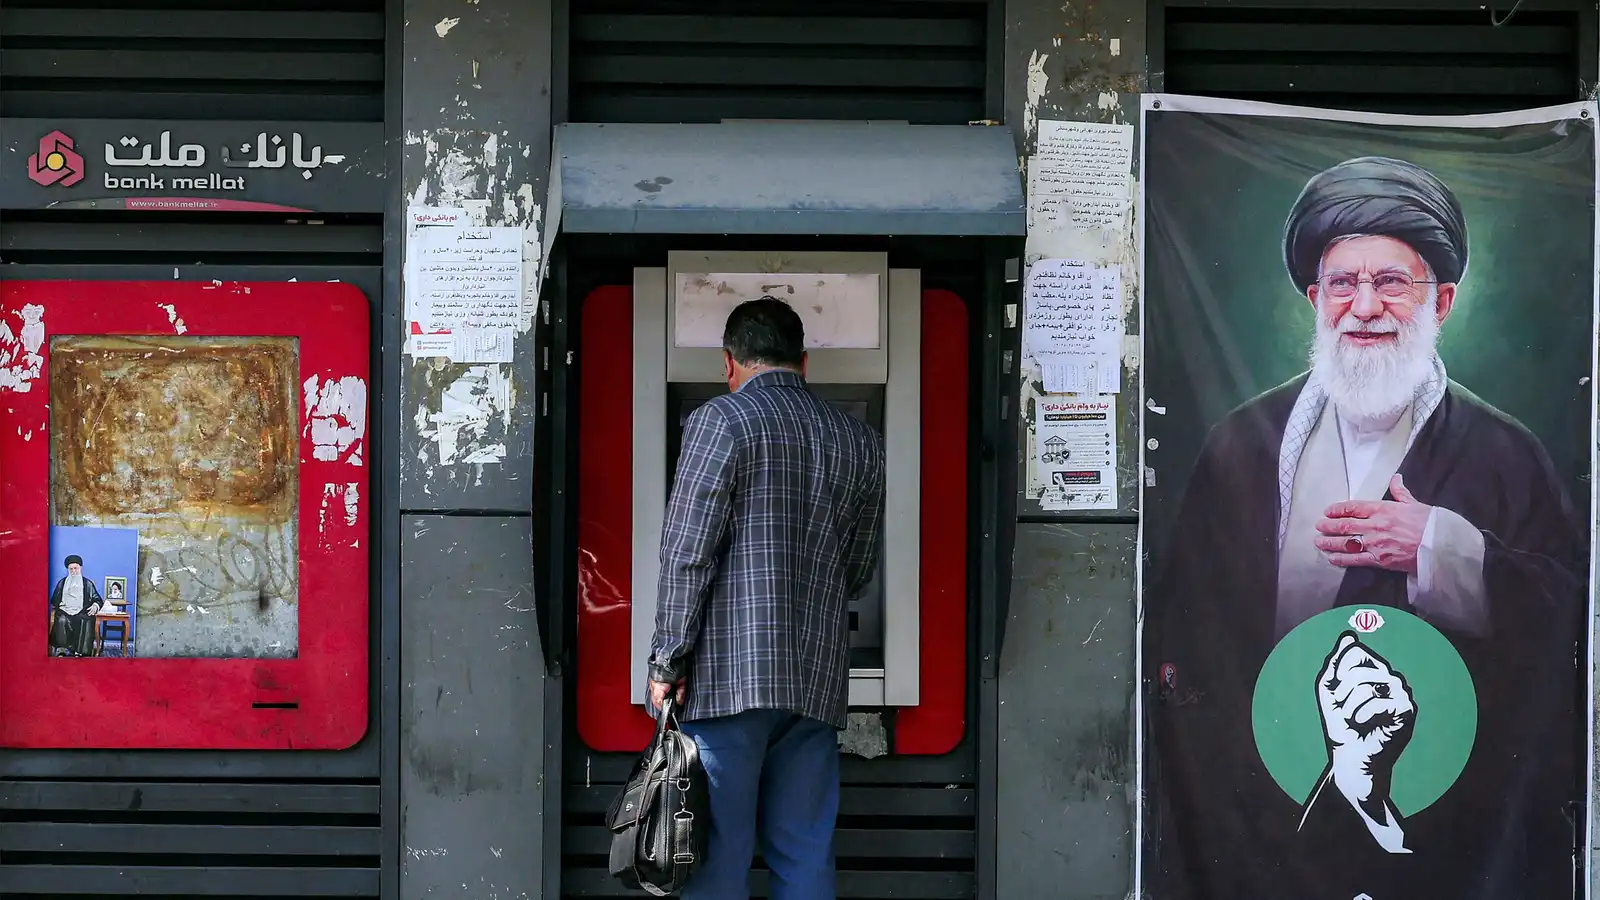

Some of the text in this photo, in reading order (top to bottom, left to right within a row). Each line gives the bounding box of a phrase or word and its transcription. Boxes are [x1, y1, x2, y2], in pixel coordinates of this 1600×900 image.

[105, 130, 207, 166] ملت
[104, 172, 246, 190] bank mellat
[457, 231, 492, 244] استخدام
[1059, 272, 1076, 280] وخانم
[1060, 403, 1076, 411] بانکی
